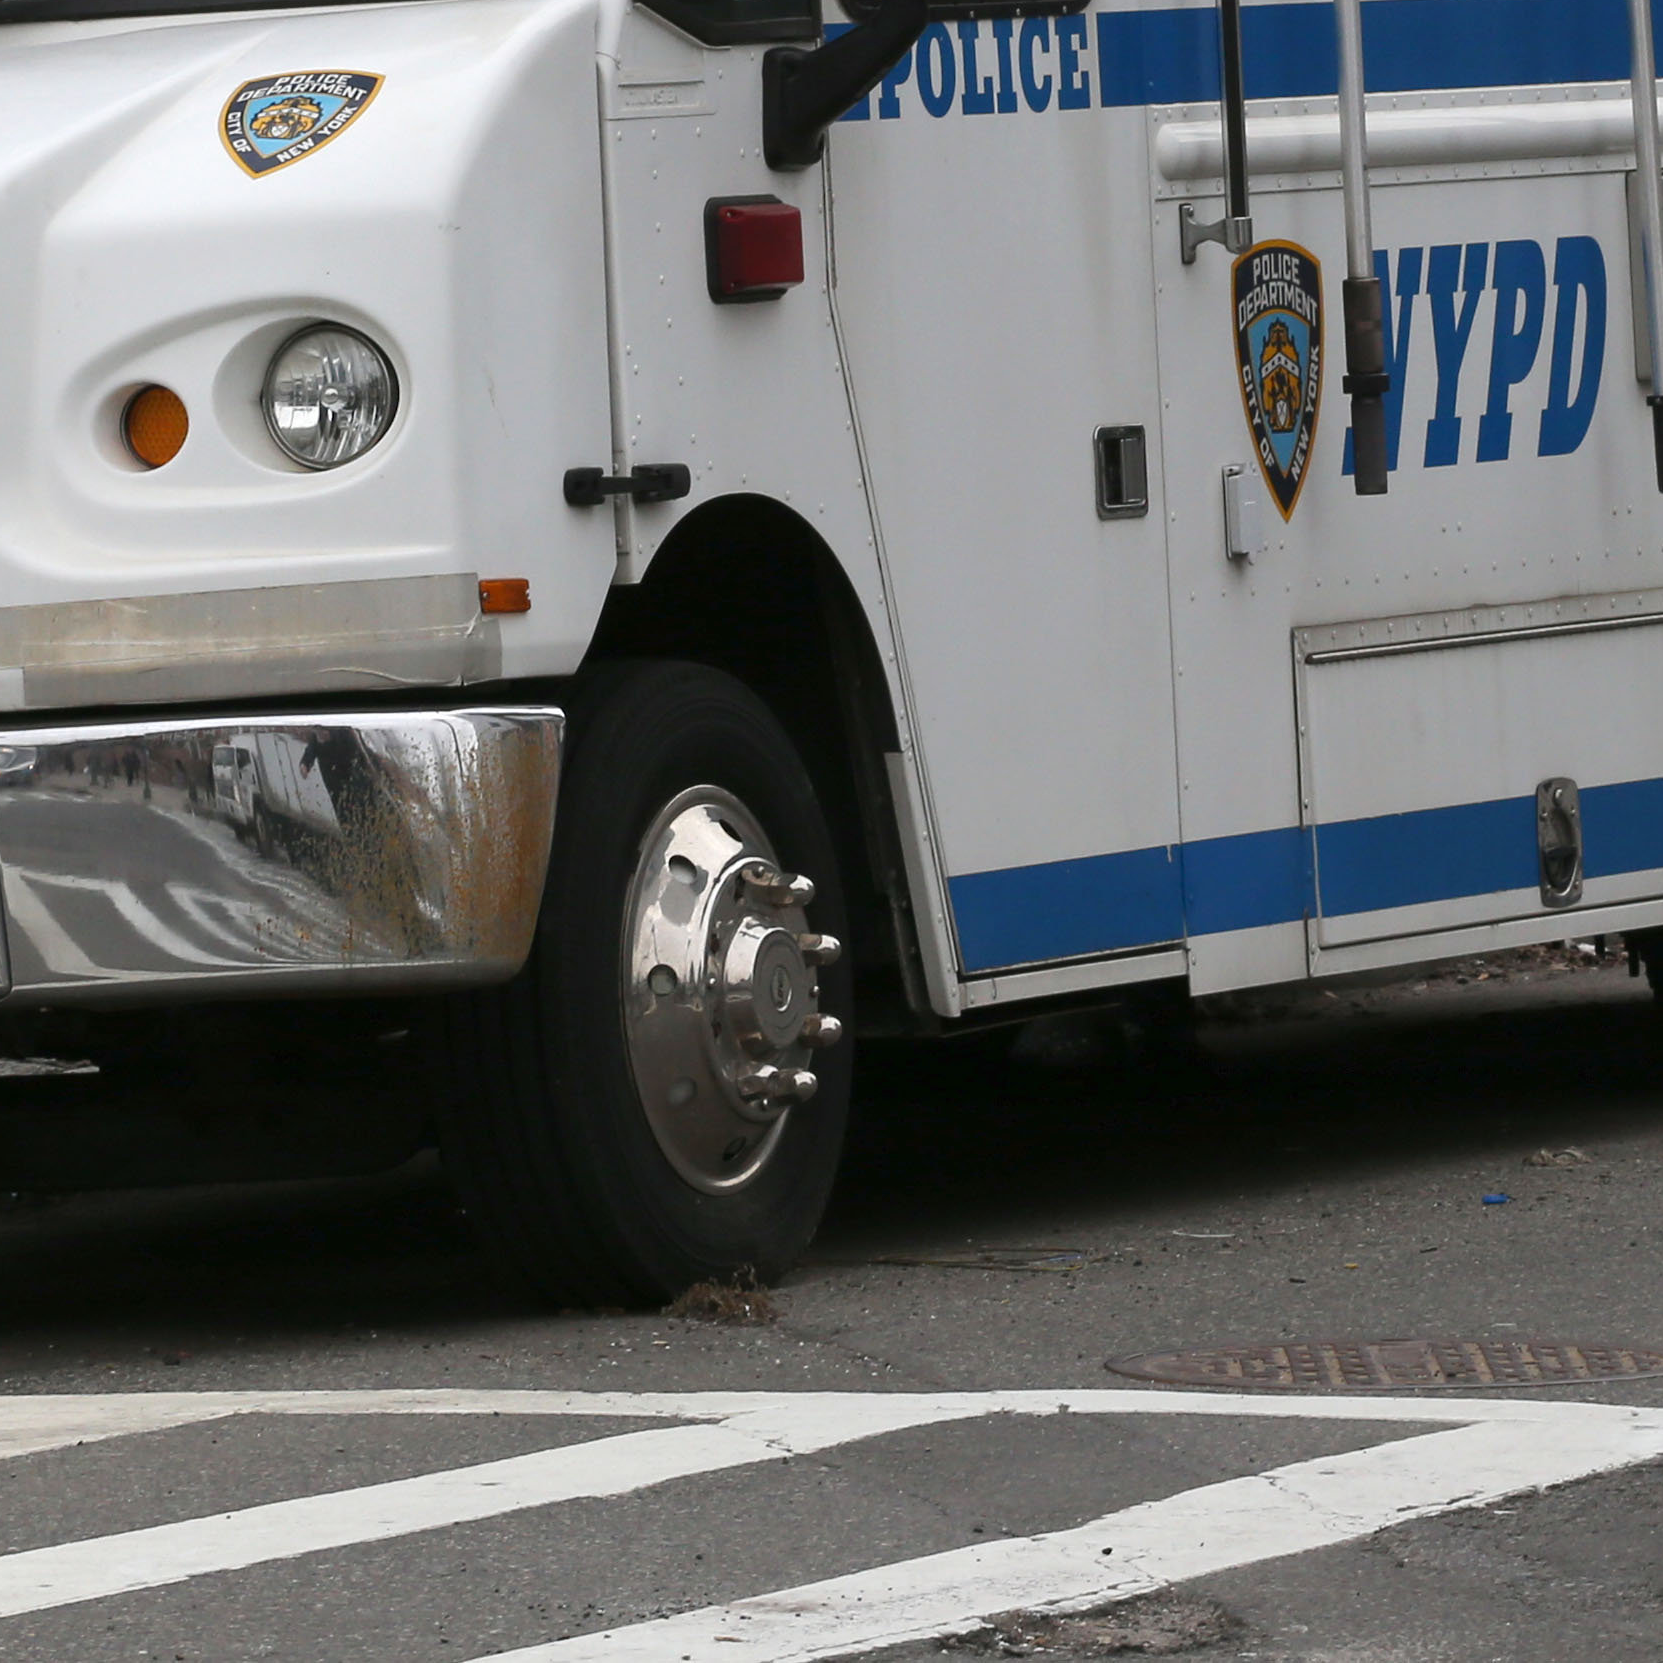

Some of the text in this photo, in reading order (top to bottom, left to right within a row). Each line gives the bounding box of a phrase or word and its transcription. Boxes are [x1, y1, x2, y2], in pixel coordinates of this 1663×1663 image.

[236, 83, 368, 103] DEPARTMENT
[272, 73, 354, 87] POLICE
[227, 106, 358, 163] CITY OF NEW YORK
[1253, 252, 1301, 286] POLICE
[1237, 280, 1318, 333] DEPARTMENT
[1341, 235, 1608, 476] NYPD
[1241, 344, 1321, 482] CITY OF NEW YORK
